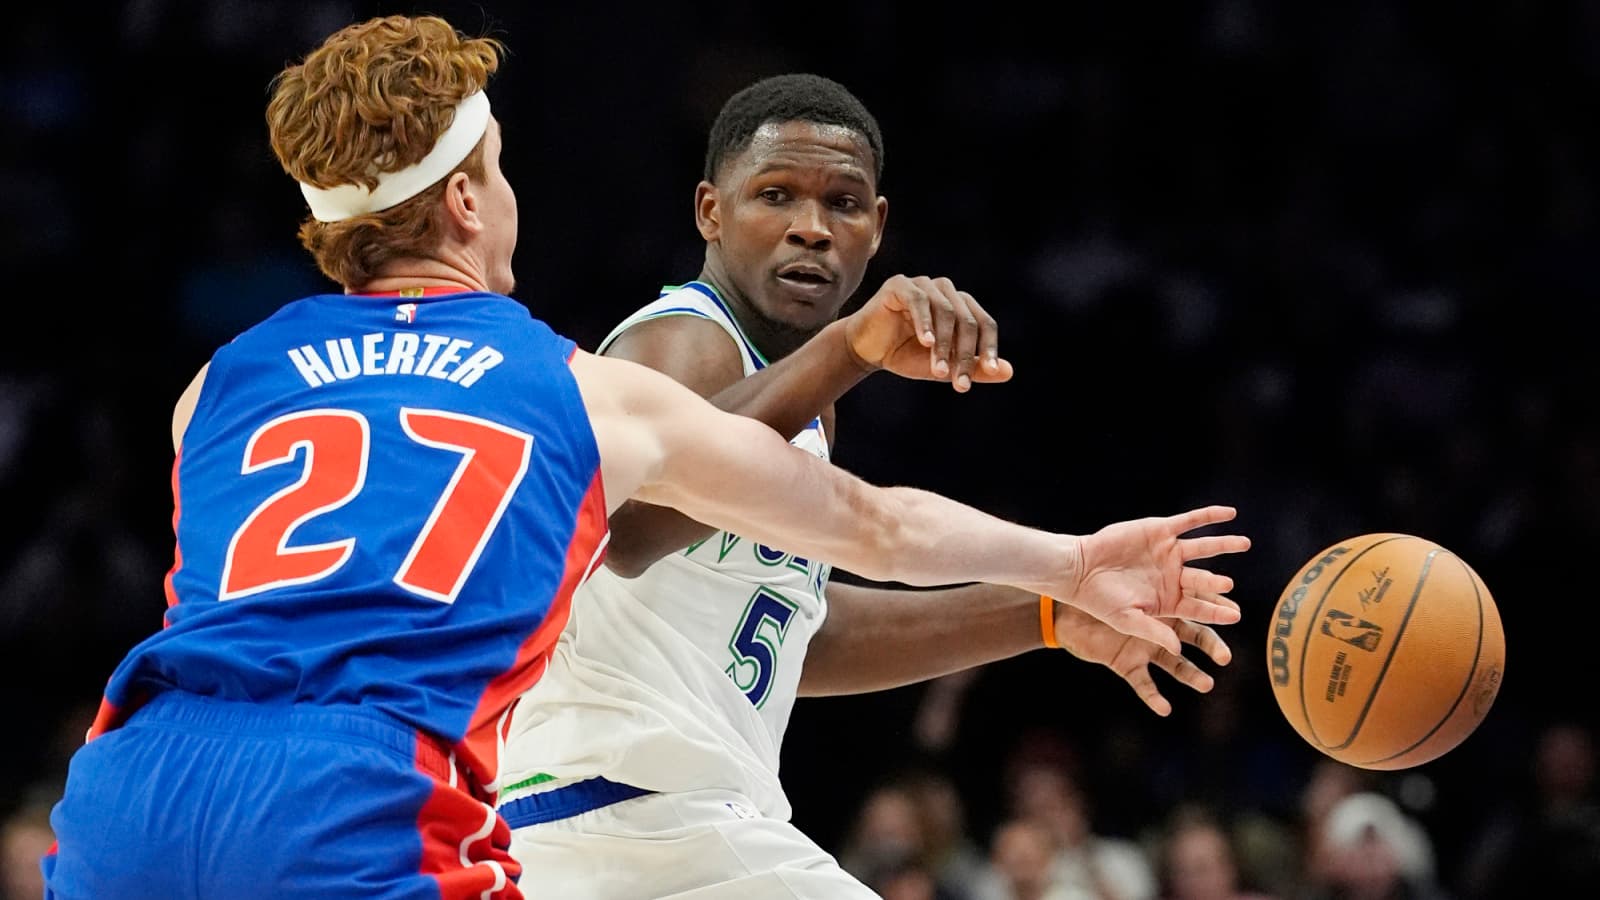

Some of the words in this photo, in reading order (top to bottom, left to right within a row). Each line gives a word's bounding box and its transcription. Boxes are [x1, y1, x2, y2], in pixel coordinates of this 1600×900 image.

[287, 332, 504, 388] HUERTER
[218, 406, 535, 604] 27
[725, 585, 800, 711] 5
